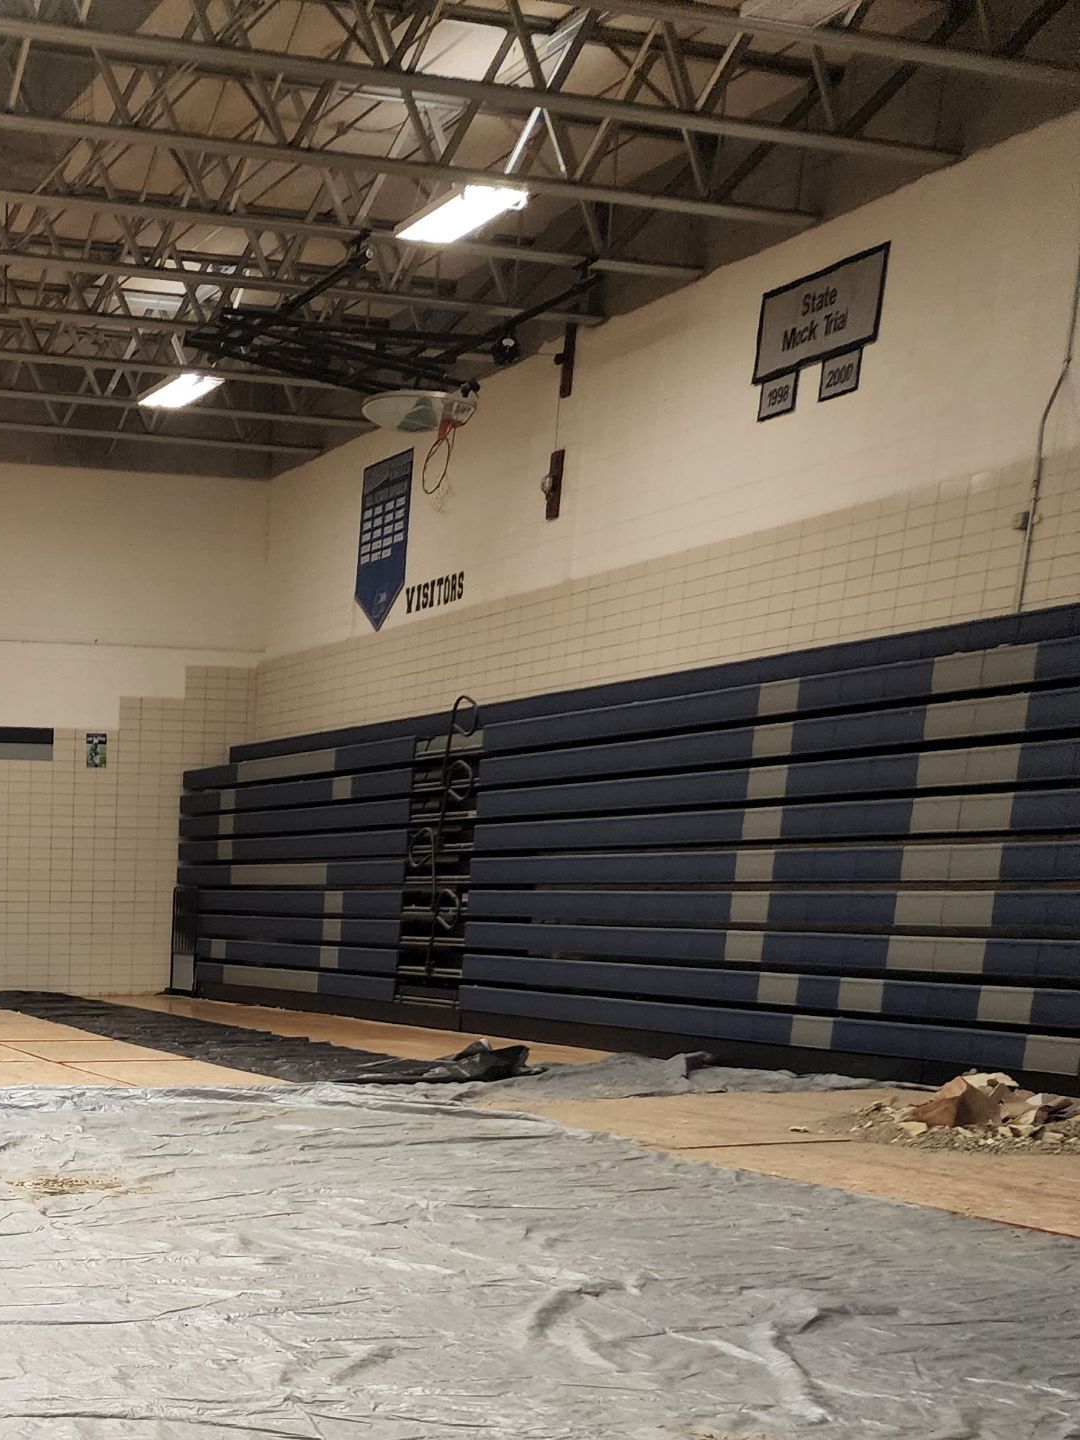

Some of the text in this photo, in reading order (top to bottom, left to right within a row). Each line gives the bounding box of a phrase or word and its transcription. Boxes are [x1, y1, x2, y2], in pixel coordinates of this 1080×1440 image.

[802, 287, 837, 316] State
[782, 307, 848, 352] Mock Trial
[825, 362, 854, 389] 2000
[405, 570, 465, 614] VISITORS
